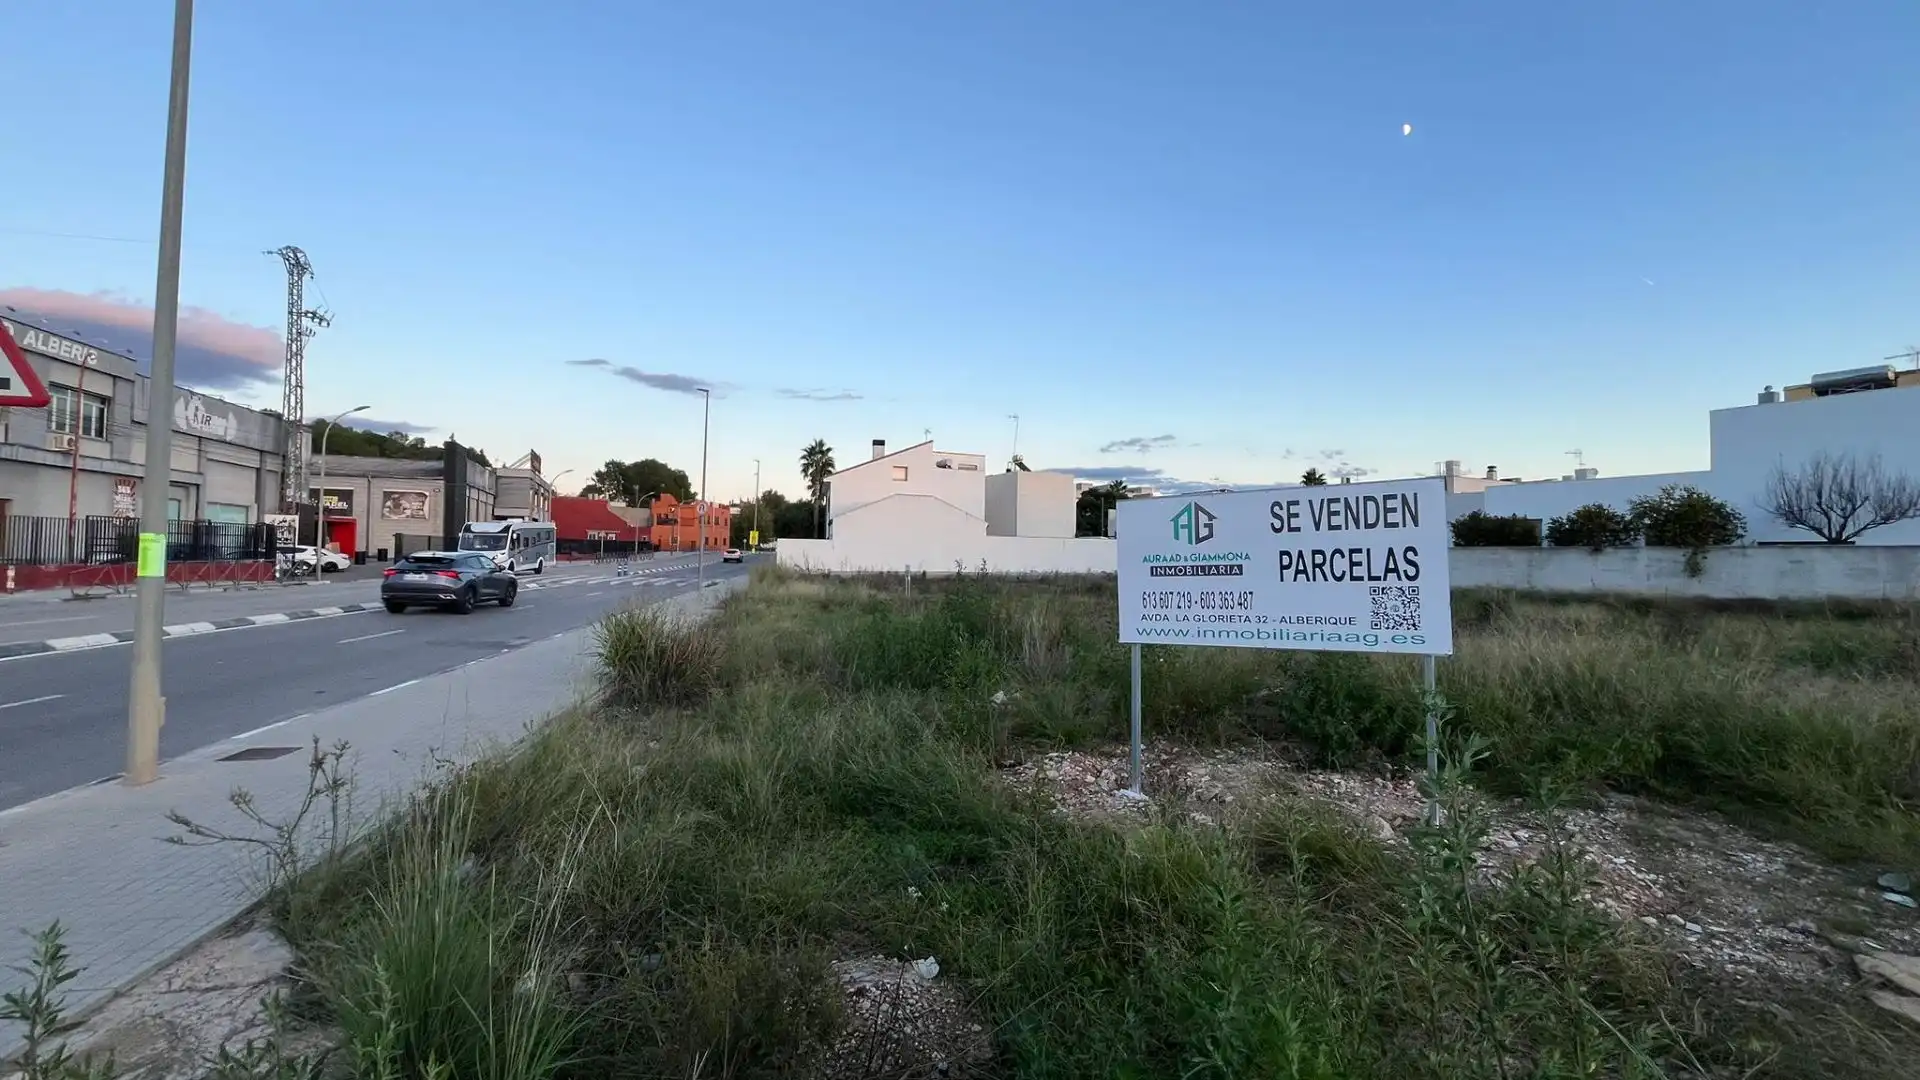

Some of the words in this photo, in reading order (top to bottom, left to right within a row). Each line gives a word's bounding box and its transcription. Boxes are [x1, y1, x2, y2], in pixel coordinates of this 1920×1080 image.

[1270, 500, 1301, 533] SE
[1308, 492, 1419, 531] VENDEN
[1142, 553, 1182, 564] AURAAD
[1190, 552, 1251, 562] GIAMMONA
[1279, 546, 1420, 582] PARCELAS
[1152, 565, 1240, 576] INMOBILIARIA
[1142, 591, 1157, 609] 613
[1160, 591, 1174, 609] 607
[1177, 591, 1192, 609] 219
[1200, 591, 1216, 610] 603
[1219, 591, 1235, 610] 363
[1238, 591, 1254, 610] 487
[1140, 613, 1169, 622] AVDA
[1176, 614, 1189, 622] LA
[1193, 614, 1252, 624] GLORIETA
[1255, 615, 1268, 624] 32
[1279, 615, 1357, 626] ALBERIQUE
[1136, 627, 1426, 646] www.inmobiliariaag.es
